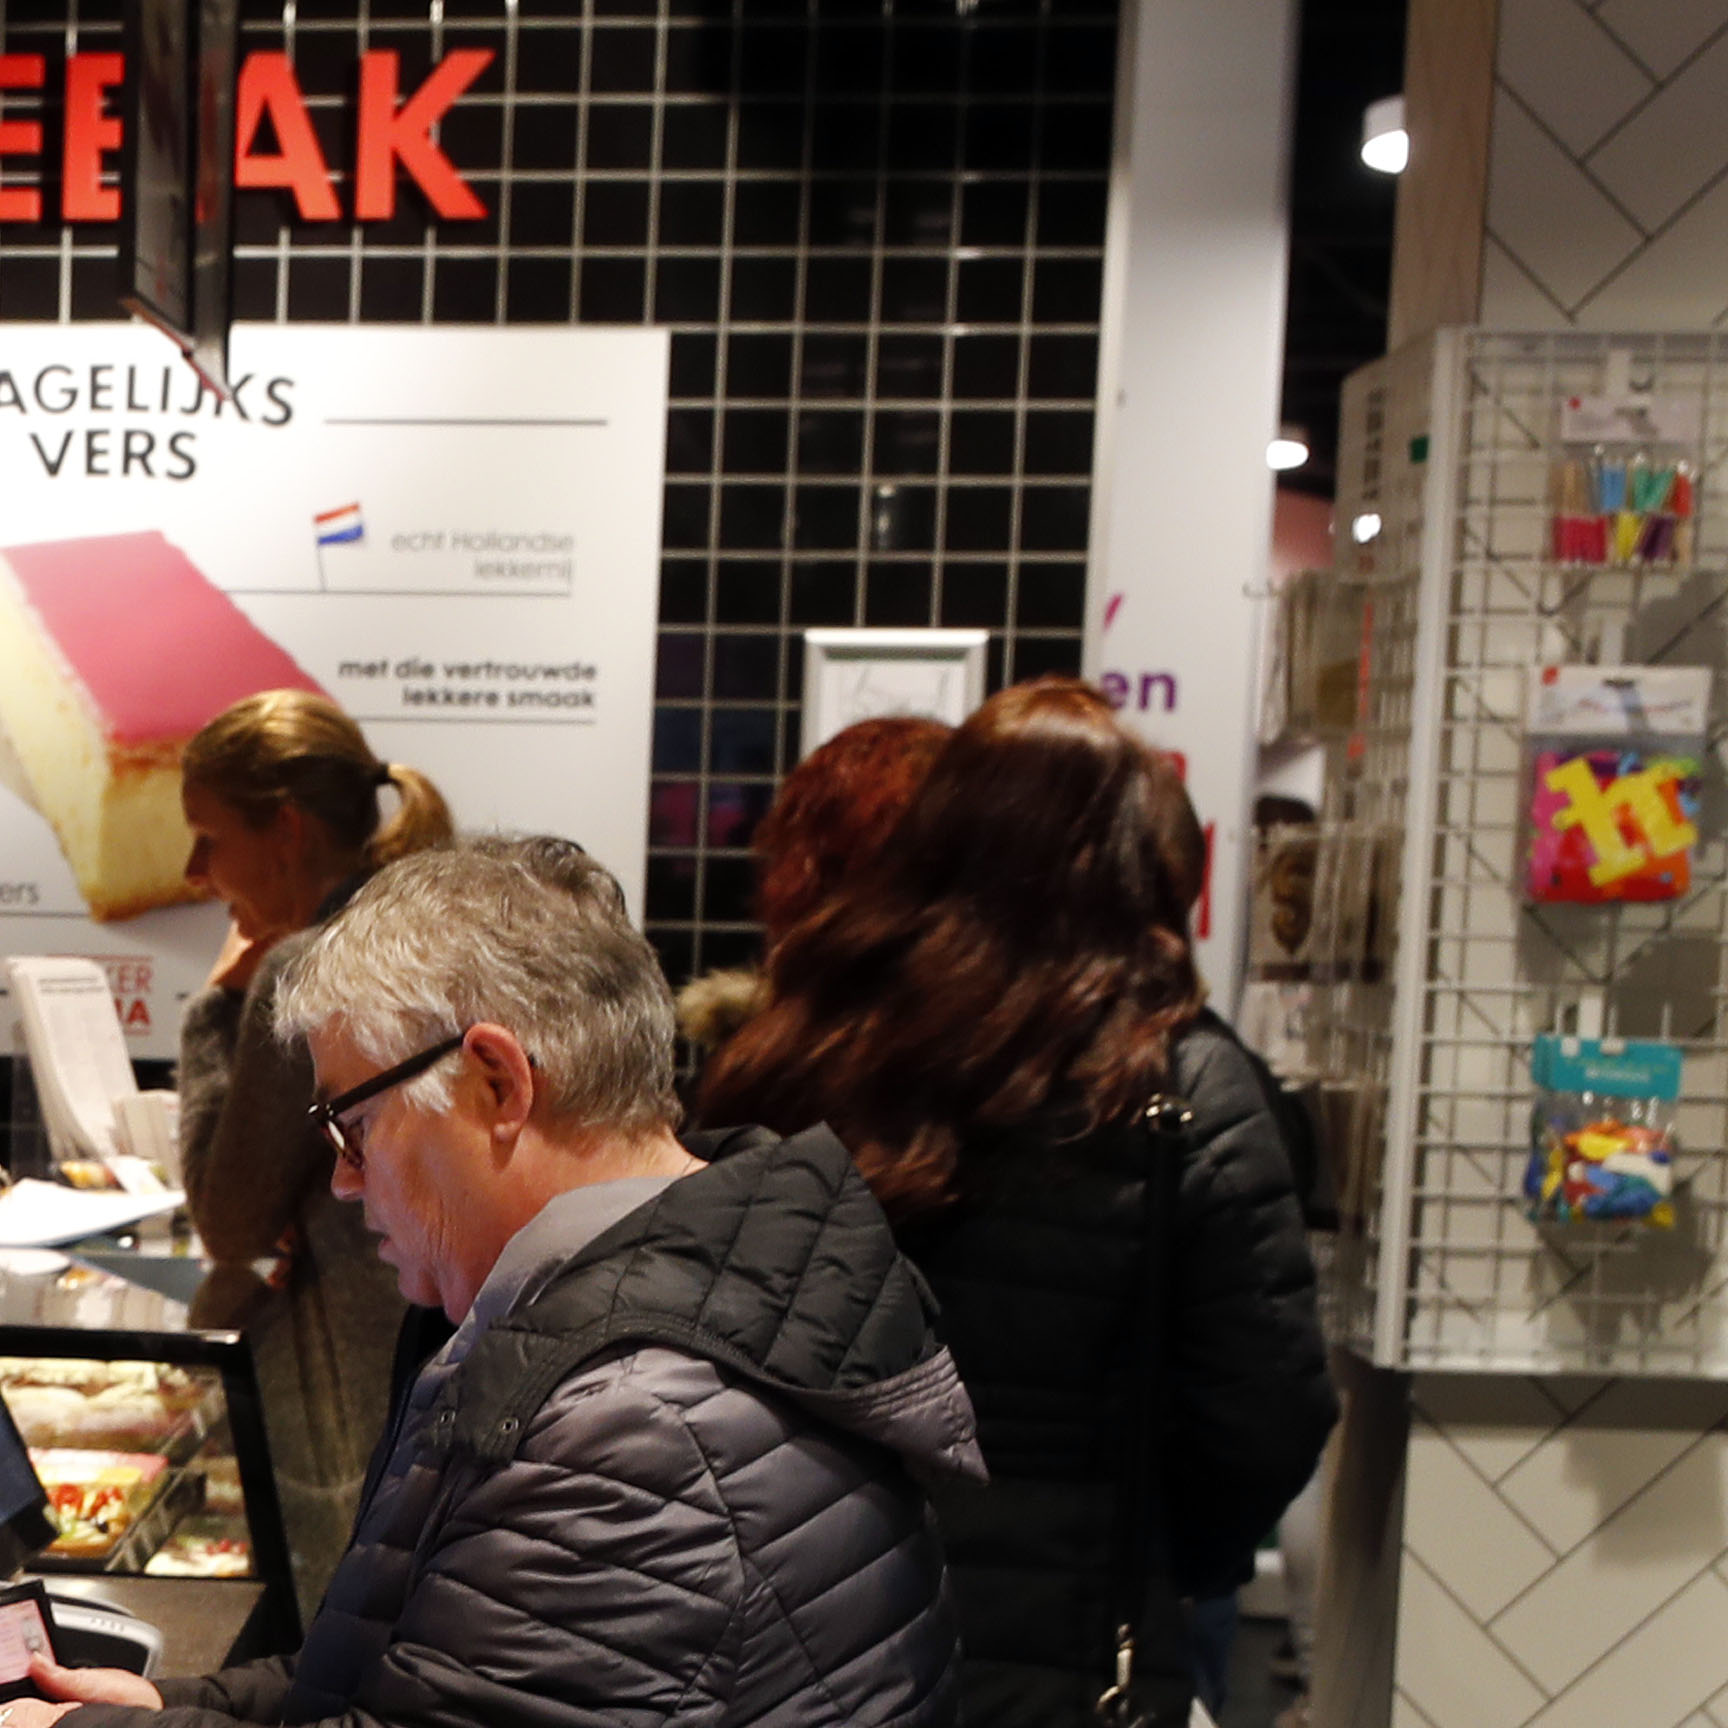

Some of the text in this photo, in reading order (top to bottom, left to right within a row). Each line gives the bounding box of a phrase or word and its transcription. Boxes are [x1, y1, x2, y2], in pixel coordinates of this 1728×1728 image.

[30, 428, 197, 481] VERS
[339, 659, 598, 682] met die vertrouwde
[402, 687, 594, 707] lekkere smaak
